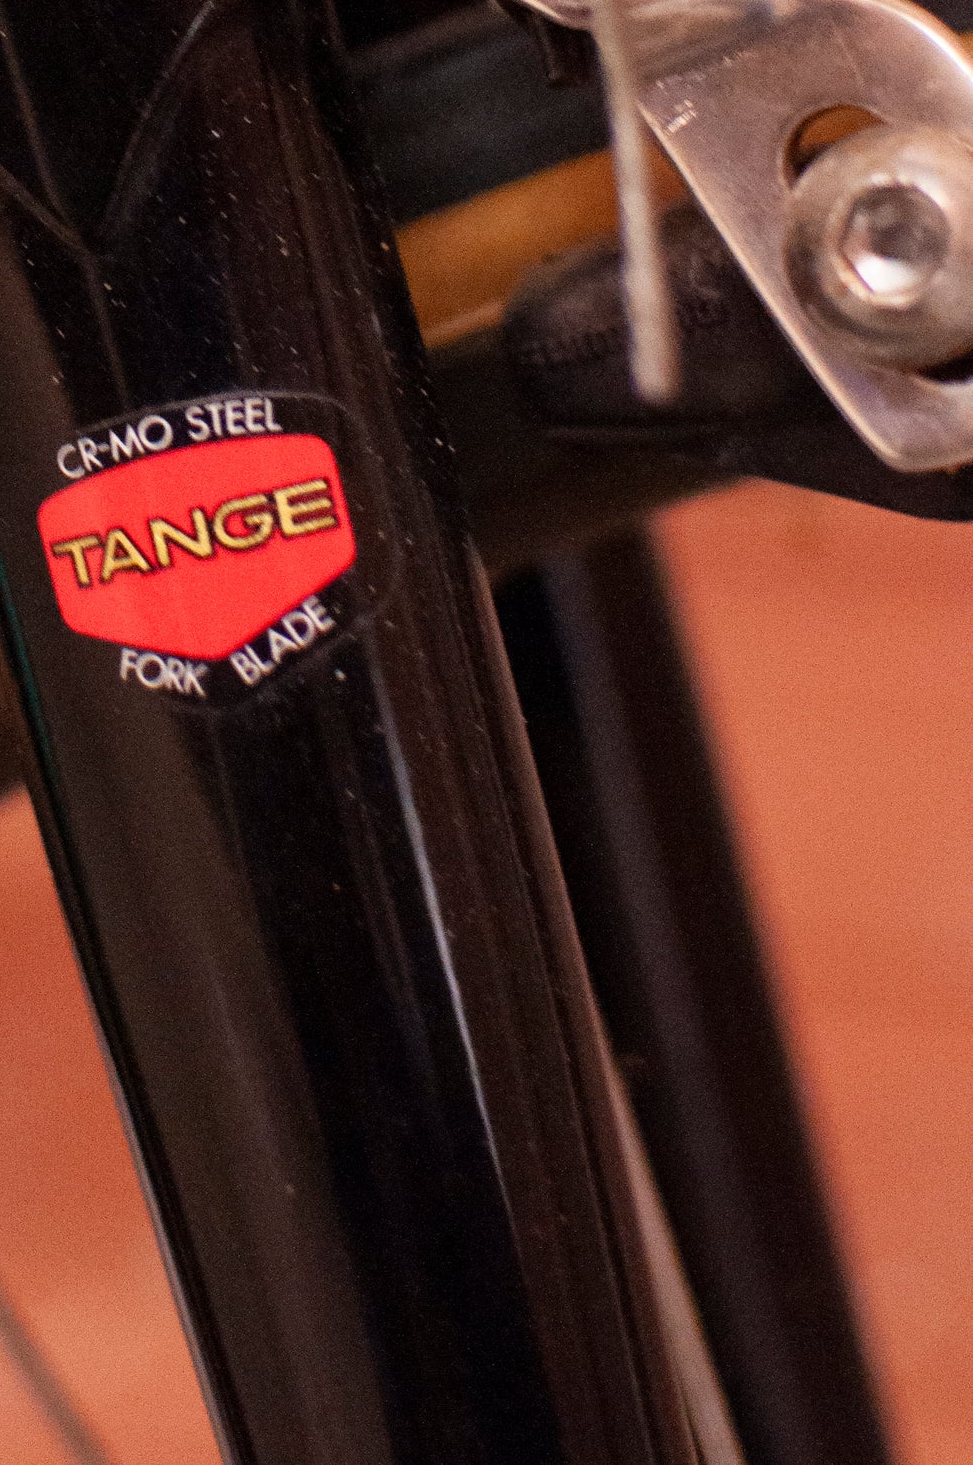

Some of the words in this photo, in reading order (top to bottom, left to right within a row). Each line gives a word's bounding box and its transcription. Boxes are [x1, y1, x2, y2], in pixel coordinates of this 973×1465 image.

[56, 415, 174, 480] CR-MO
[184, 398, 283, 442] STEEL
[52, 478, 338, 588] TANGE
[119, 648, 207, 698] FORK
[230, 596, 336, 686] BLADE
